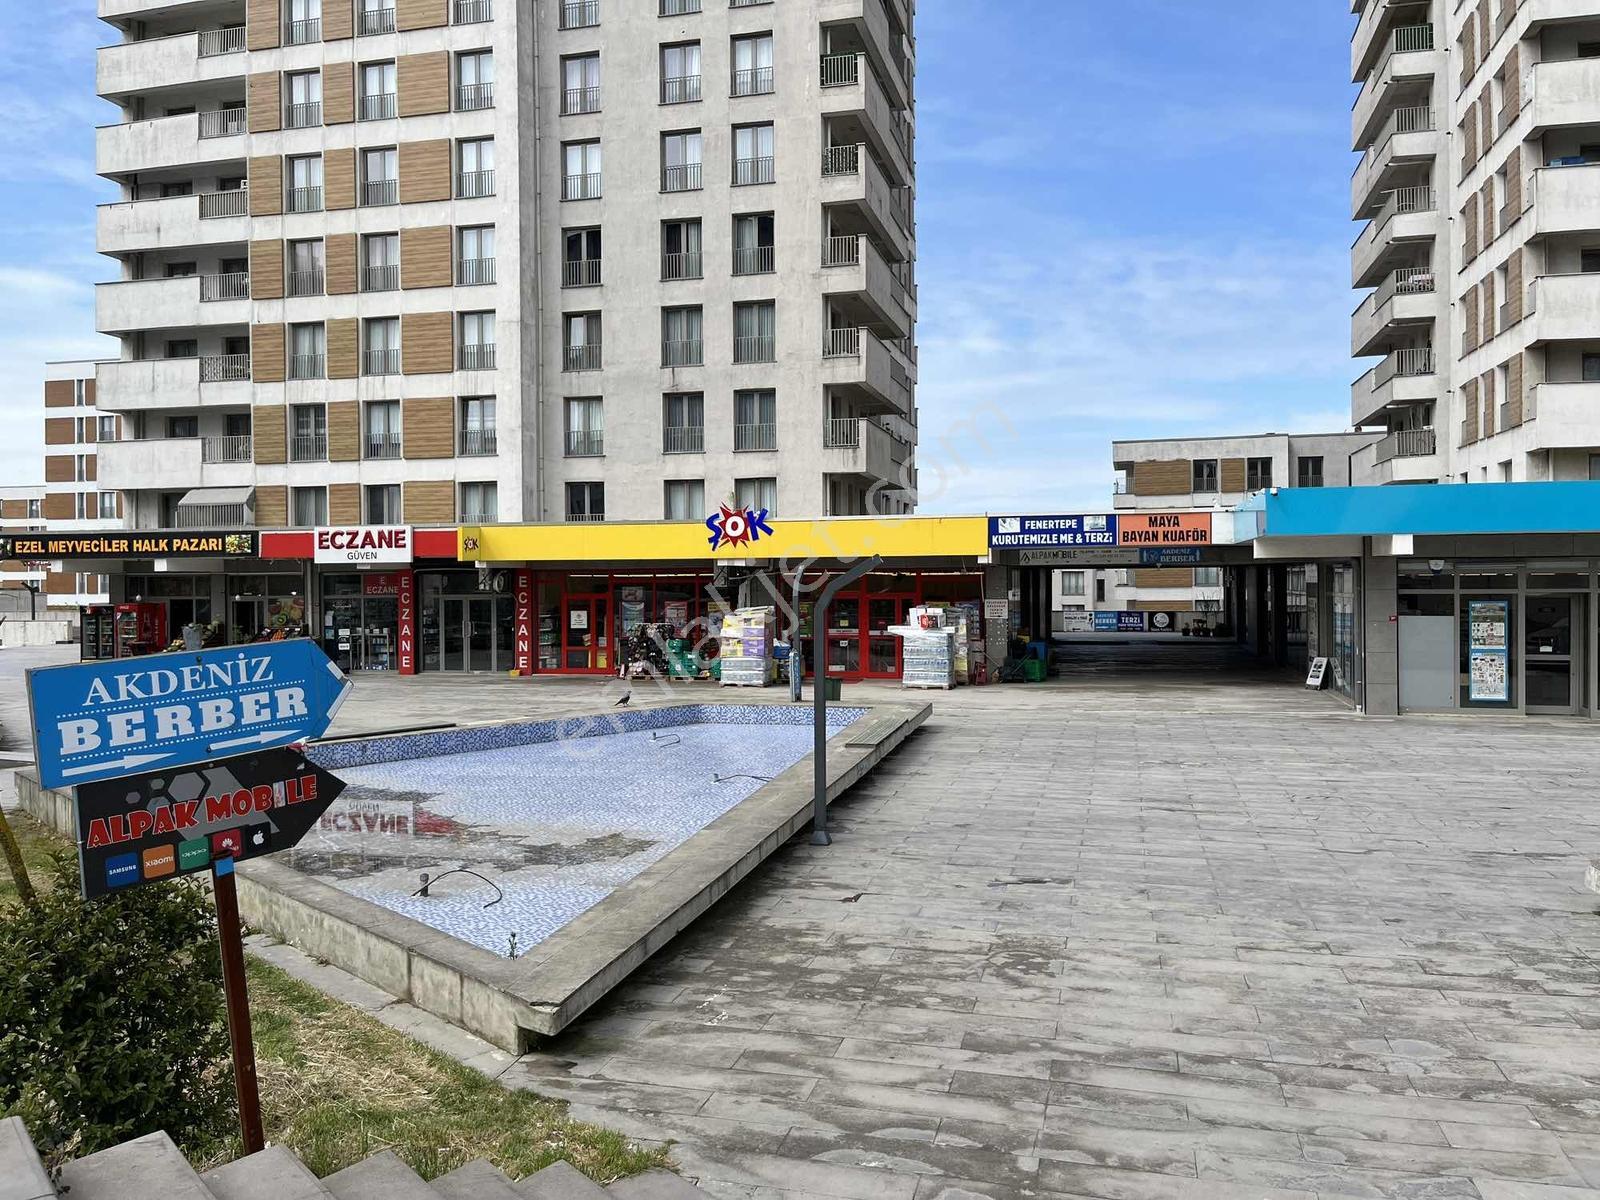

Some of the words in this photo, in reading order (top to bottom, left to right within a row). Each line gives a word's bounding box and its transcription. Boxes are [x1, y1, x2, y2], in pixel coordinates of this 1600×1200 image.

[1025, 519, 1077, 530] FENERTEPE
[1148, 516, 1180, 528] MAYA
[318, 529, 407, 549] ECZANE
[1076, 533, 1083, 543] &
[1122, 530, 1159, 542] BAYAN
[1162, 528, 1207, 542] KUAFÖR
[15, 541, 46, 553] EZEL
[48, 537, 129, 553] MEYVECİLER
[133, 539, 169, 552] HALK
[172, 538, 223, 551] PAZARI
[347, 551, 378, 560] GÜVEN
[366, 586, 400, 594] ECZANE
[401, 576, 412, 668] ECZANE
[518, 576, 529, 668] ECZANE
[82, 653, 275, 706] AKDENİZ
[57, 687, 308, 755] BERBER
[87, 800, 199, 849] ALPAK
[109, 864, 137, 875] SAMSUNG
